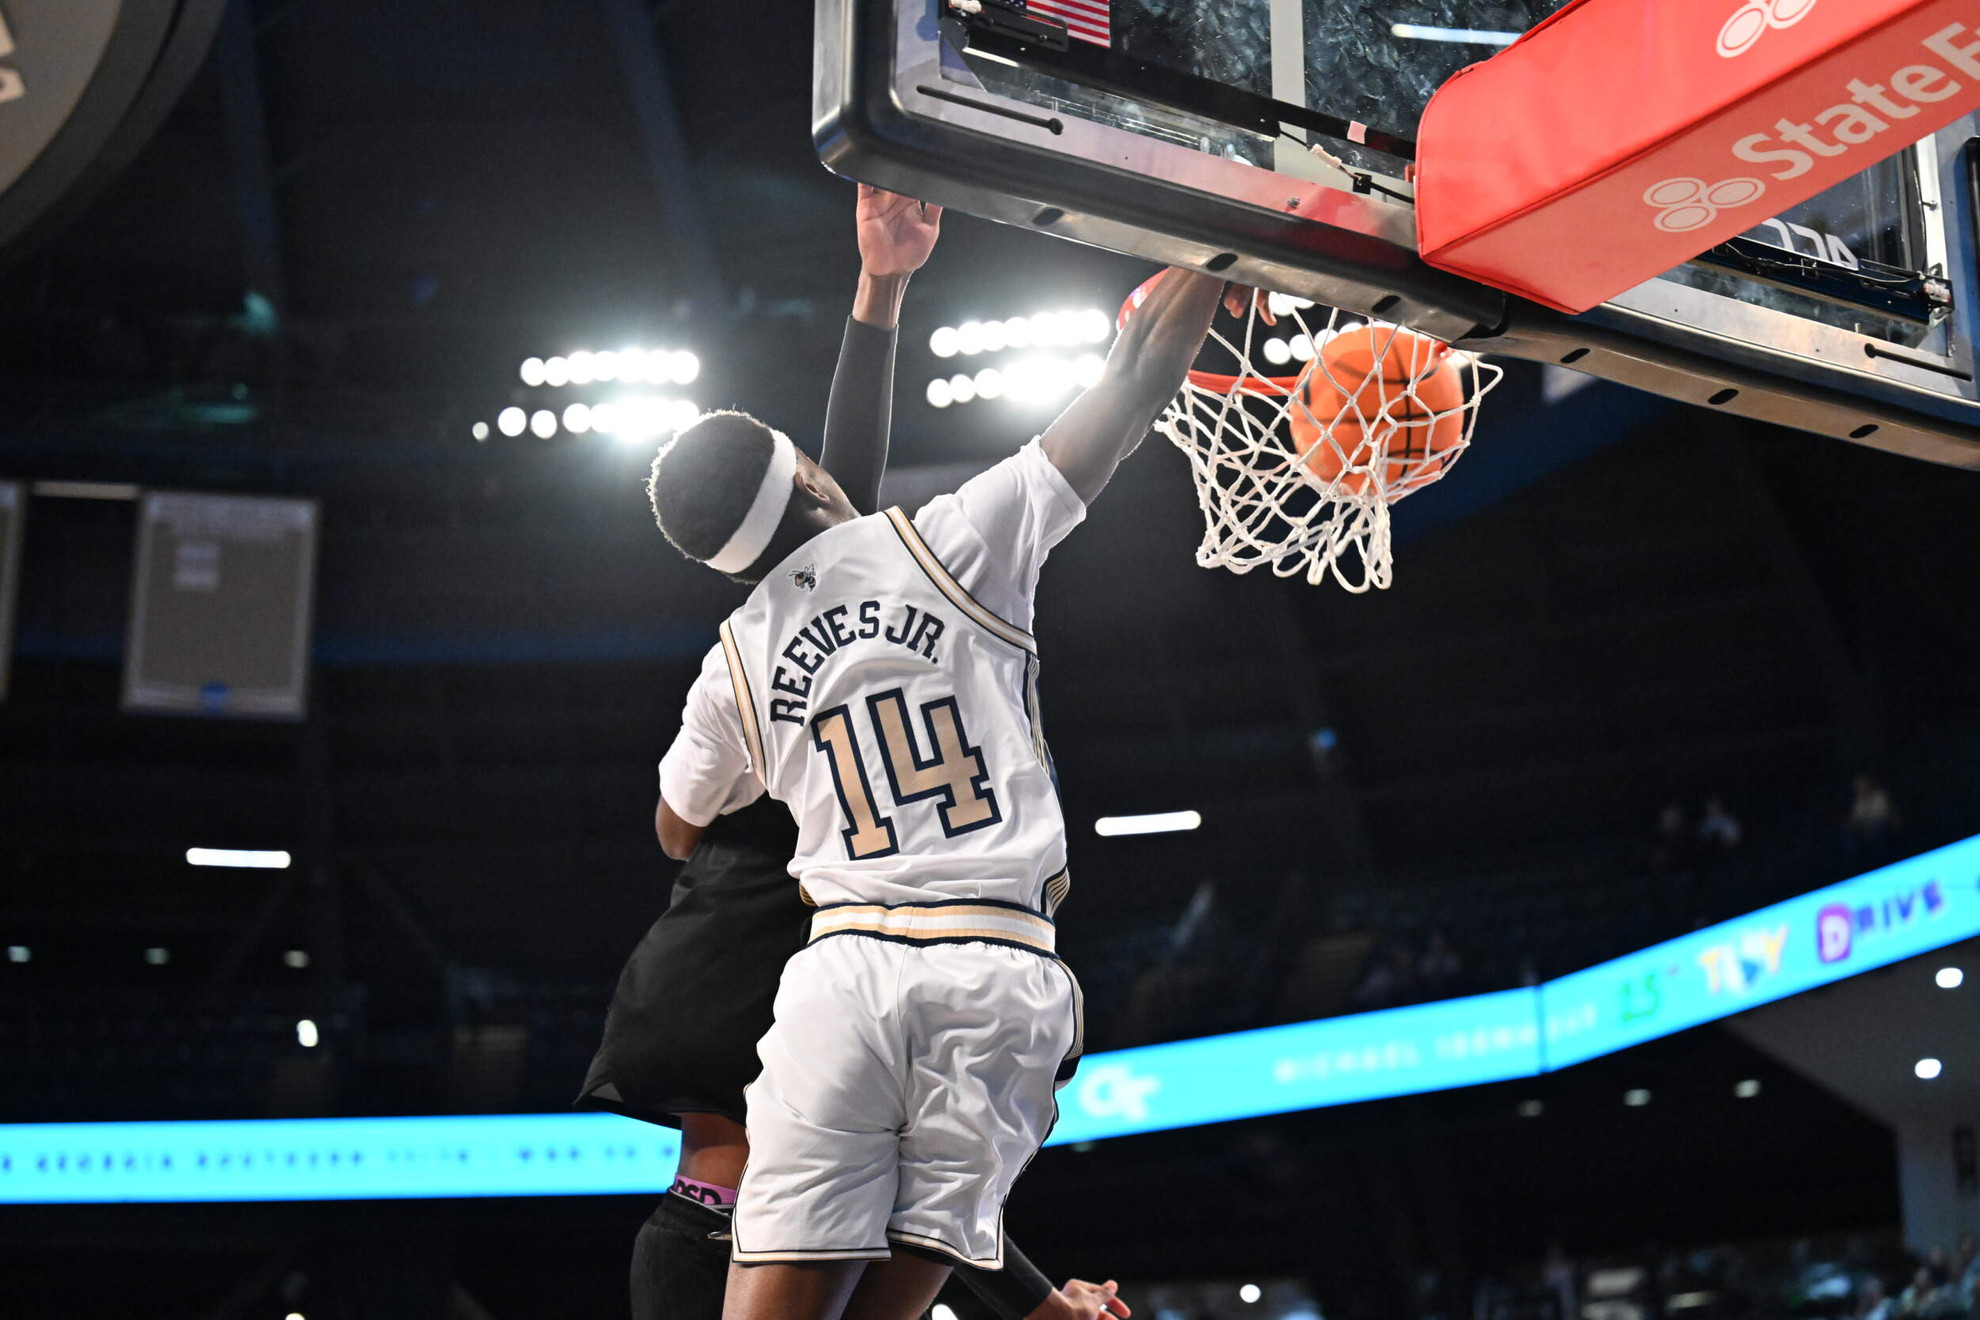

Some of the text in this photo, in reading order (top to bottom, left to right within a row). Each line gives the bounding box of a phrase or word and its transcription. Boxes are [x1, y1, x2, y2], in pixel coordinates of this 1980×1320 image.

[770, 600, 946, 727] REEVES JR.
[810, 687, 1003, 861] 14
